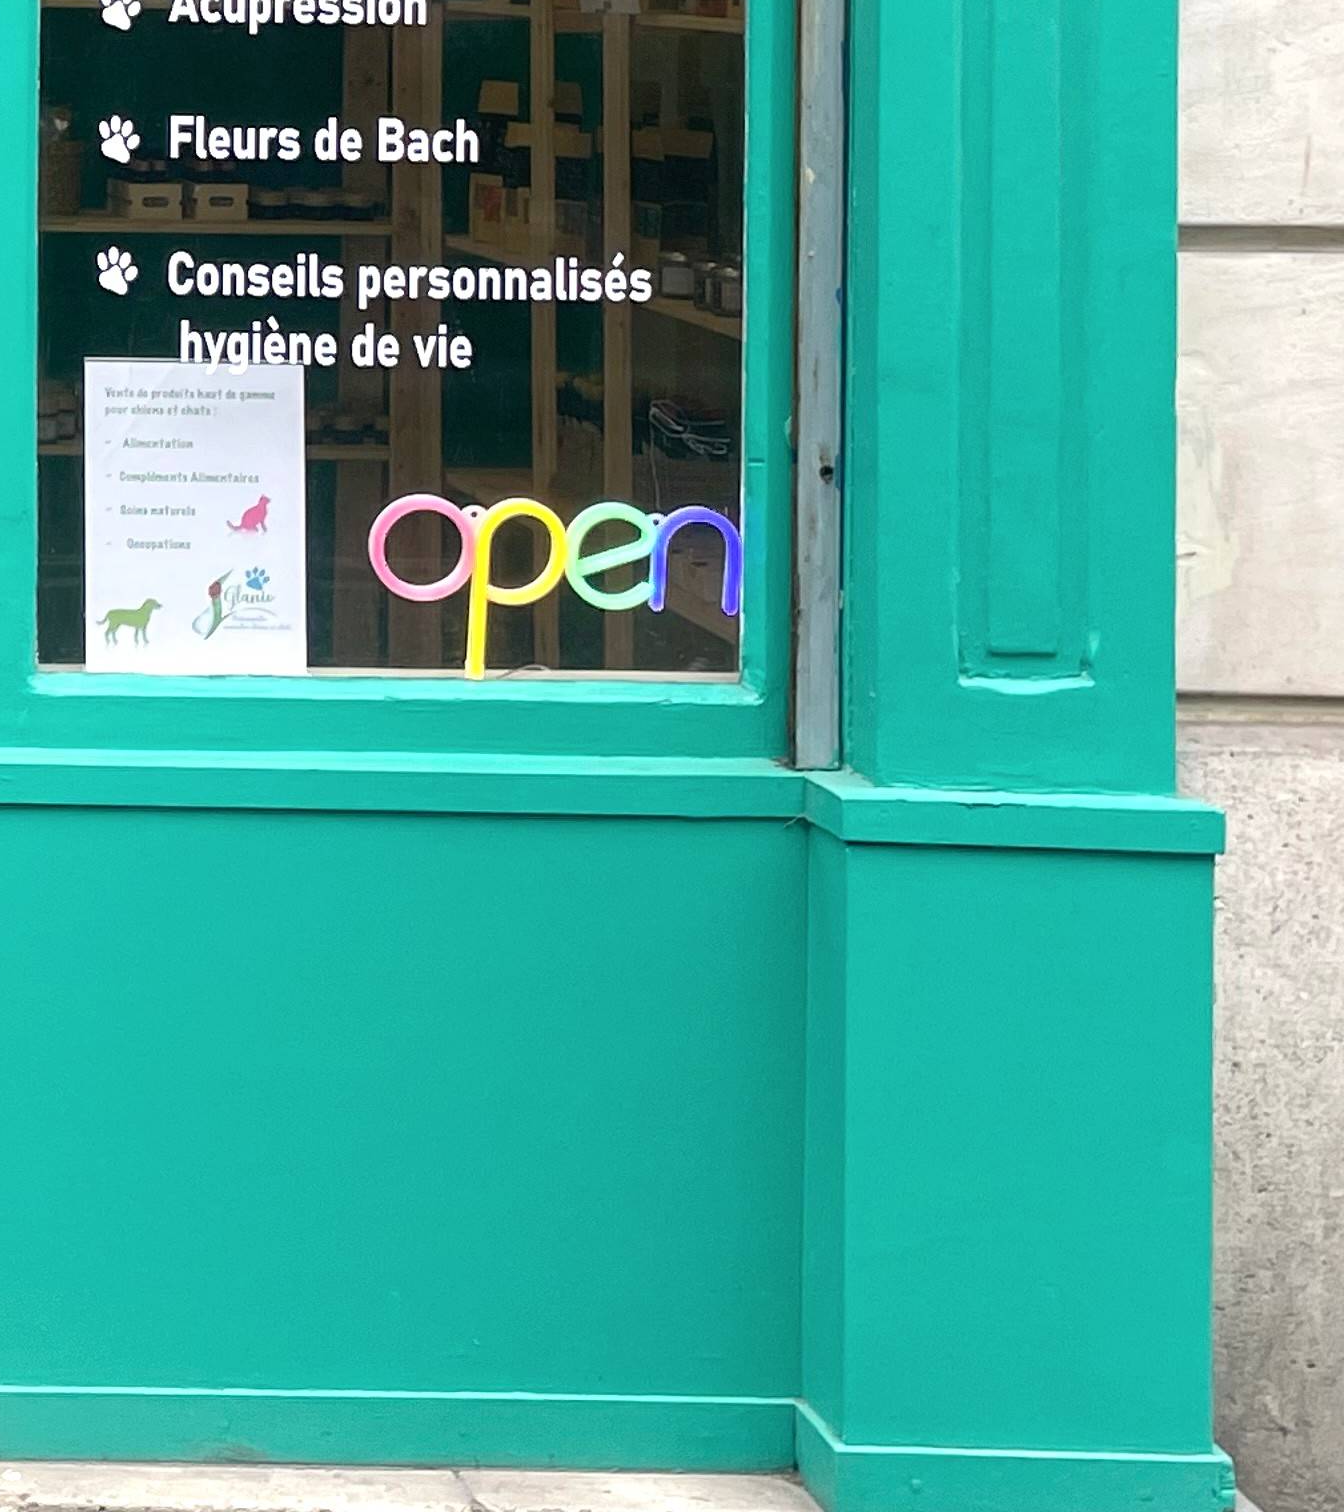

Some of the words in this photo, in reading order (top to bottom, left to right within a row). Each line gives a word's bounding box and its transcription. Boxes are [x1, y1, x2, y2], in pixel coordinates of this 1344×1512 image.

[170, 115, 300, 161] Fleurs
[314, 117, 362, 161] de
[378, 118, 479, 163] Bach
[167, 251, 344, 299] Conseils
[358, 252, 653, 311] personnalisés
[179, 315, 337, 375] hygiène
[351, 323, 400, 368] de
[413, 324, 473, 368] vie
[151, 388, 195, 402] produits
[104, 406, 128, 417] pour
[122, 437, 194, 449] Alimentation
[190, 471, 260, 484] Alimentaires
[120, 504, 148, 516] Soins
[368, 493, 743, 680] open
